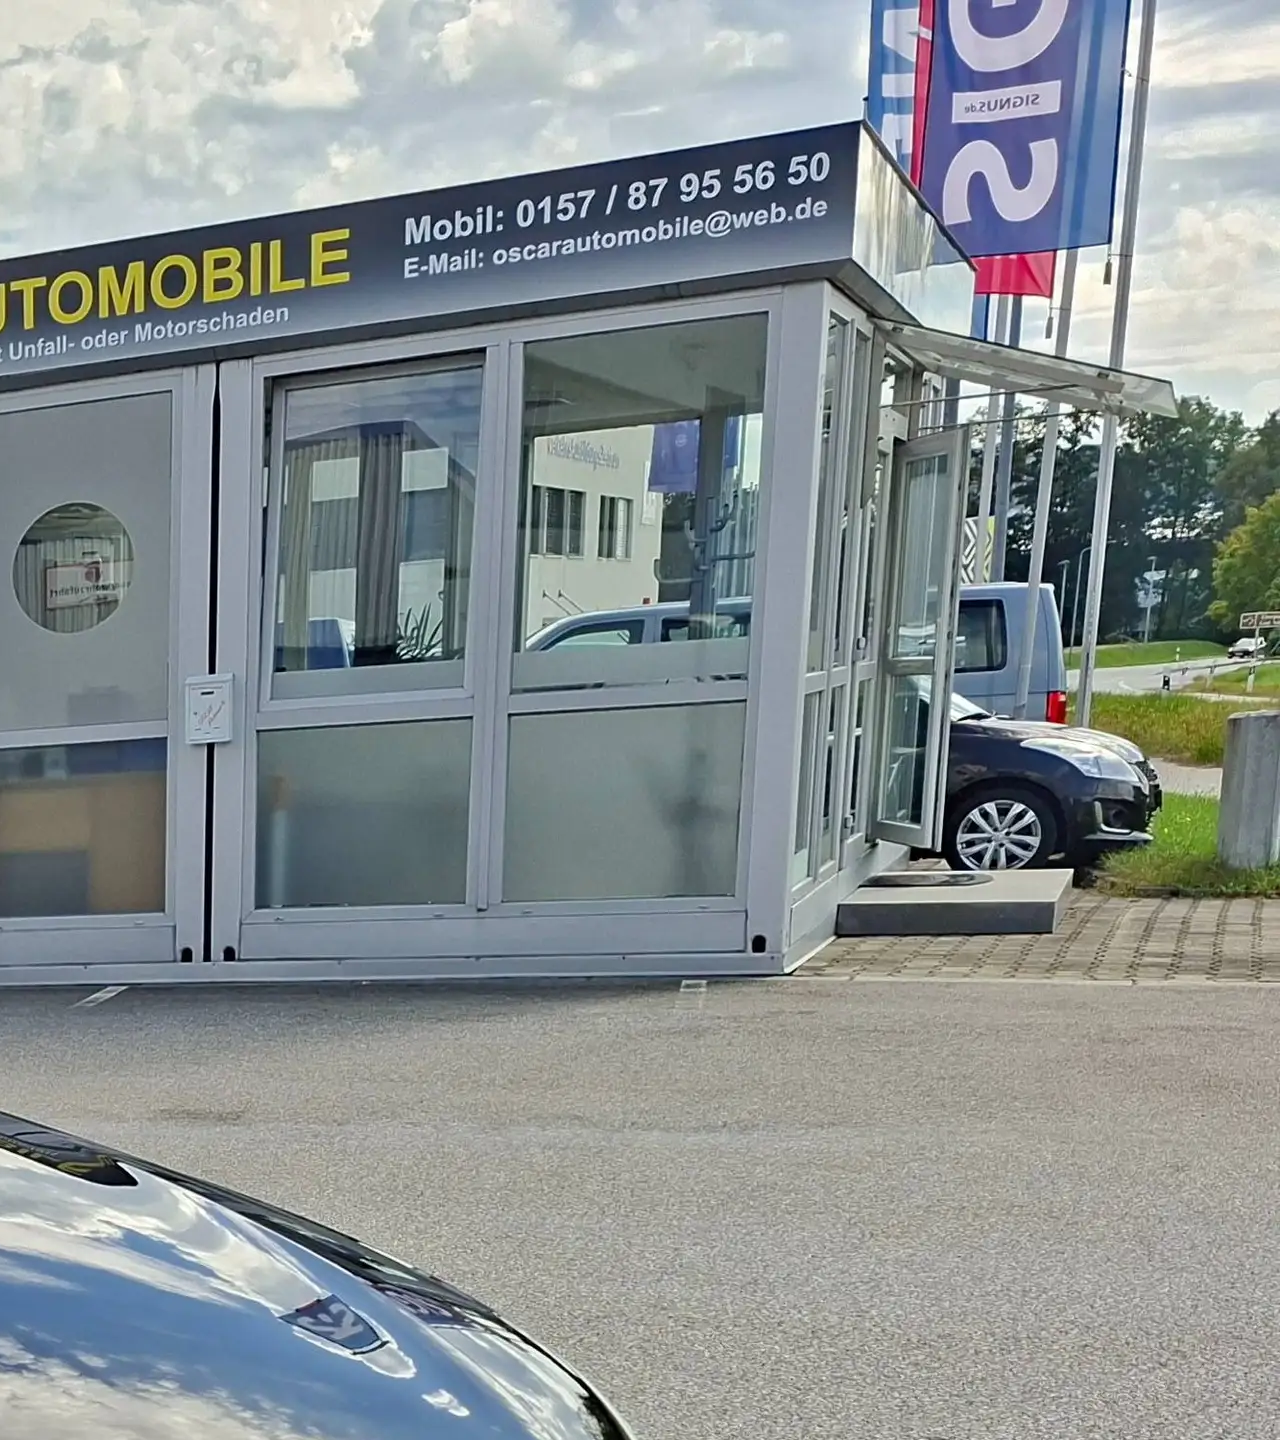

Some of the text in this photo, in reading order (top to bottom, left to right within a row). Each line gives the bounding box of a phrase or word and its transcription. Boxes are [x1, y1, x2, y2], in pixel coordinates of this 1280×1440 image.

[403, 196, 829, 279] E-Mail: oscarautomobile@web.de
[404, 151, 831, 246] Mobil: 0157 / 87 95 56 50
[8, 334, 75, 361] Unfall-
[81, 327, 129, 352] oder
[134, 305, 290, 344] Motorschaden
